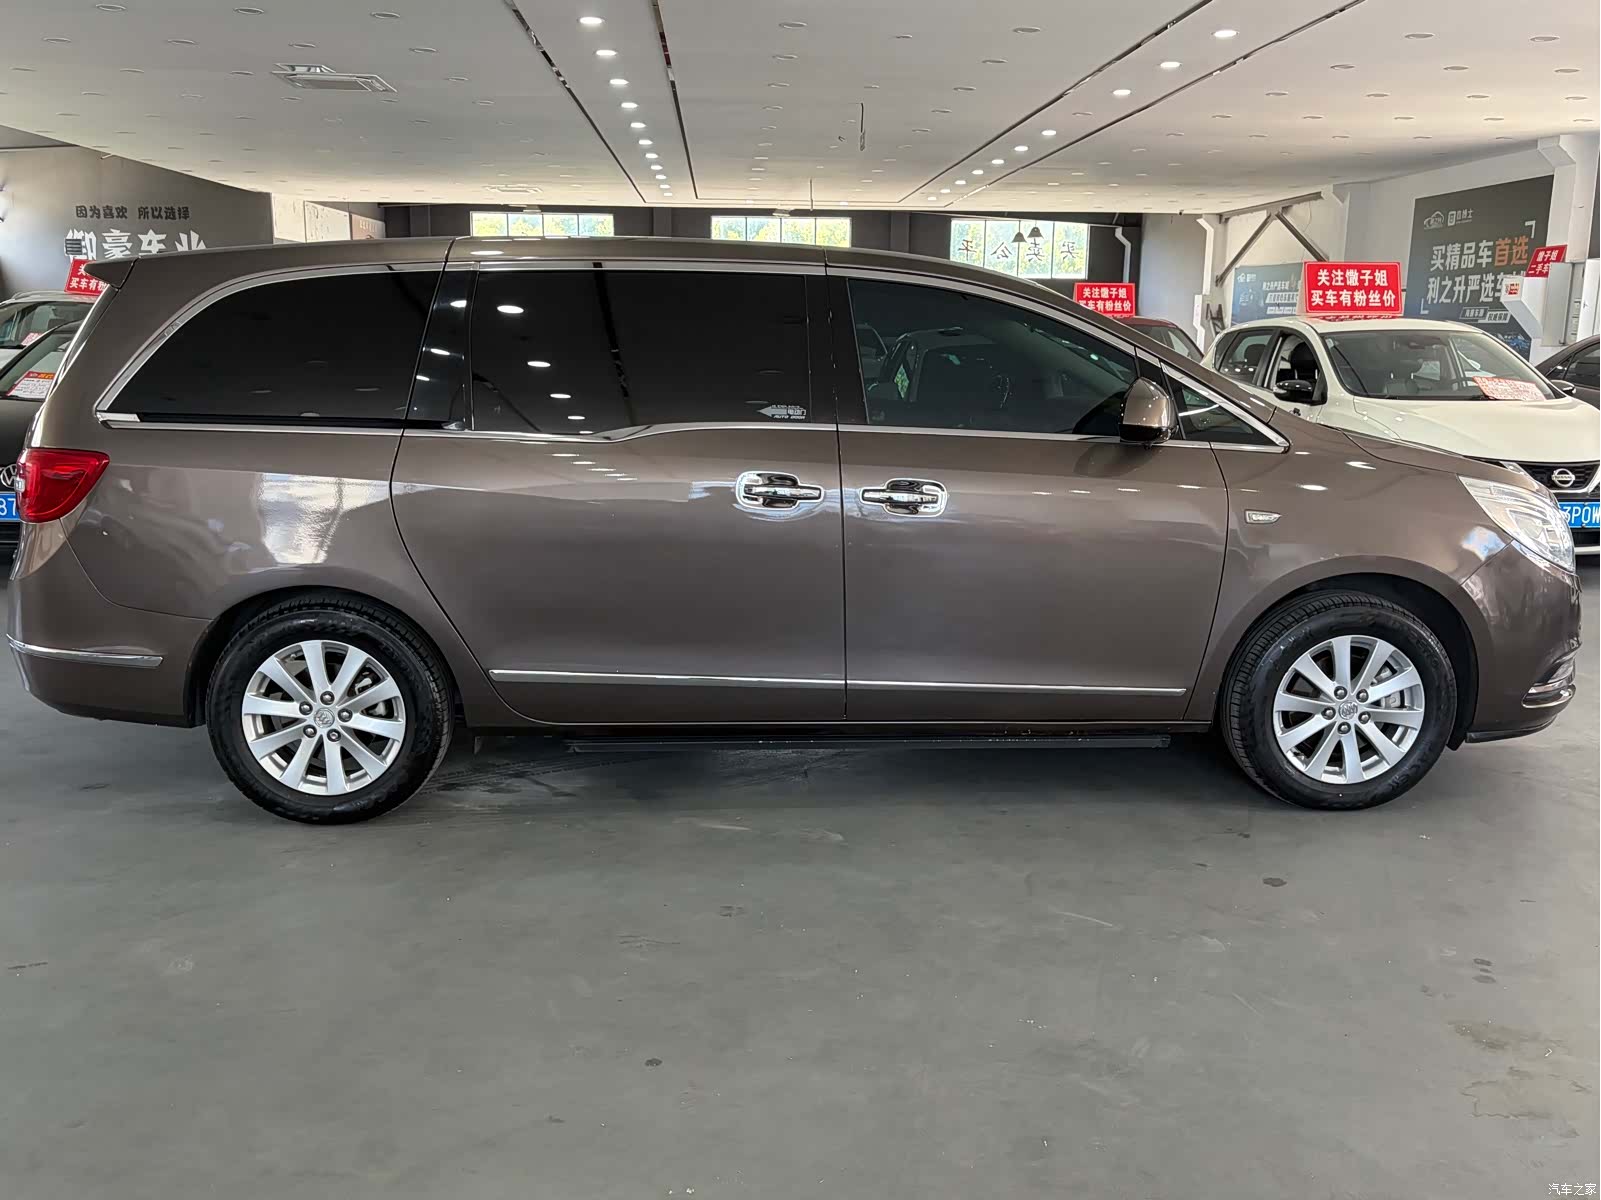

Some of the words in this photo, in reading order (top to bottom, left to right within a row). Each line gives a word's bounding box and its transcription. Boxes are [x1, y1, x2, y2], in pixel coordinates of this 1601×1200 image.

[76, 205, 128, 219] 因为喜欢
[138, 206, 190, 220] 所以选择
[1430, 235, 1529, 271] 买精品车首选
[1310, 289, 1396, 308] 买车有粉丝价
